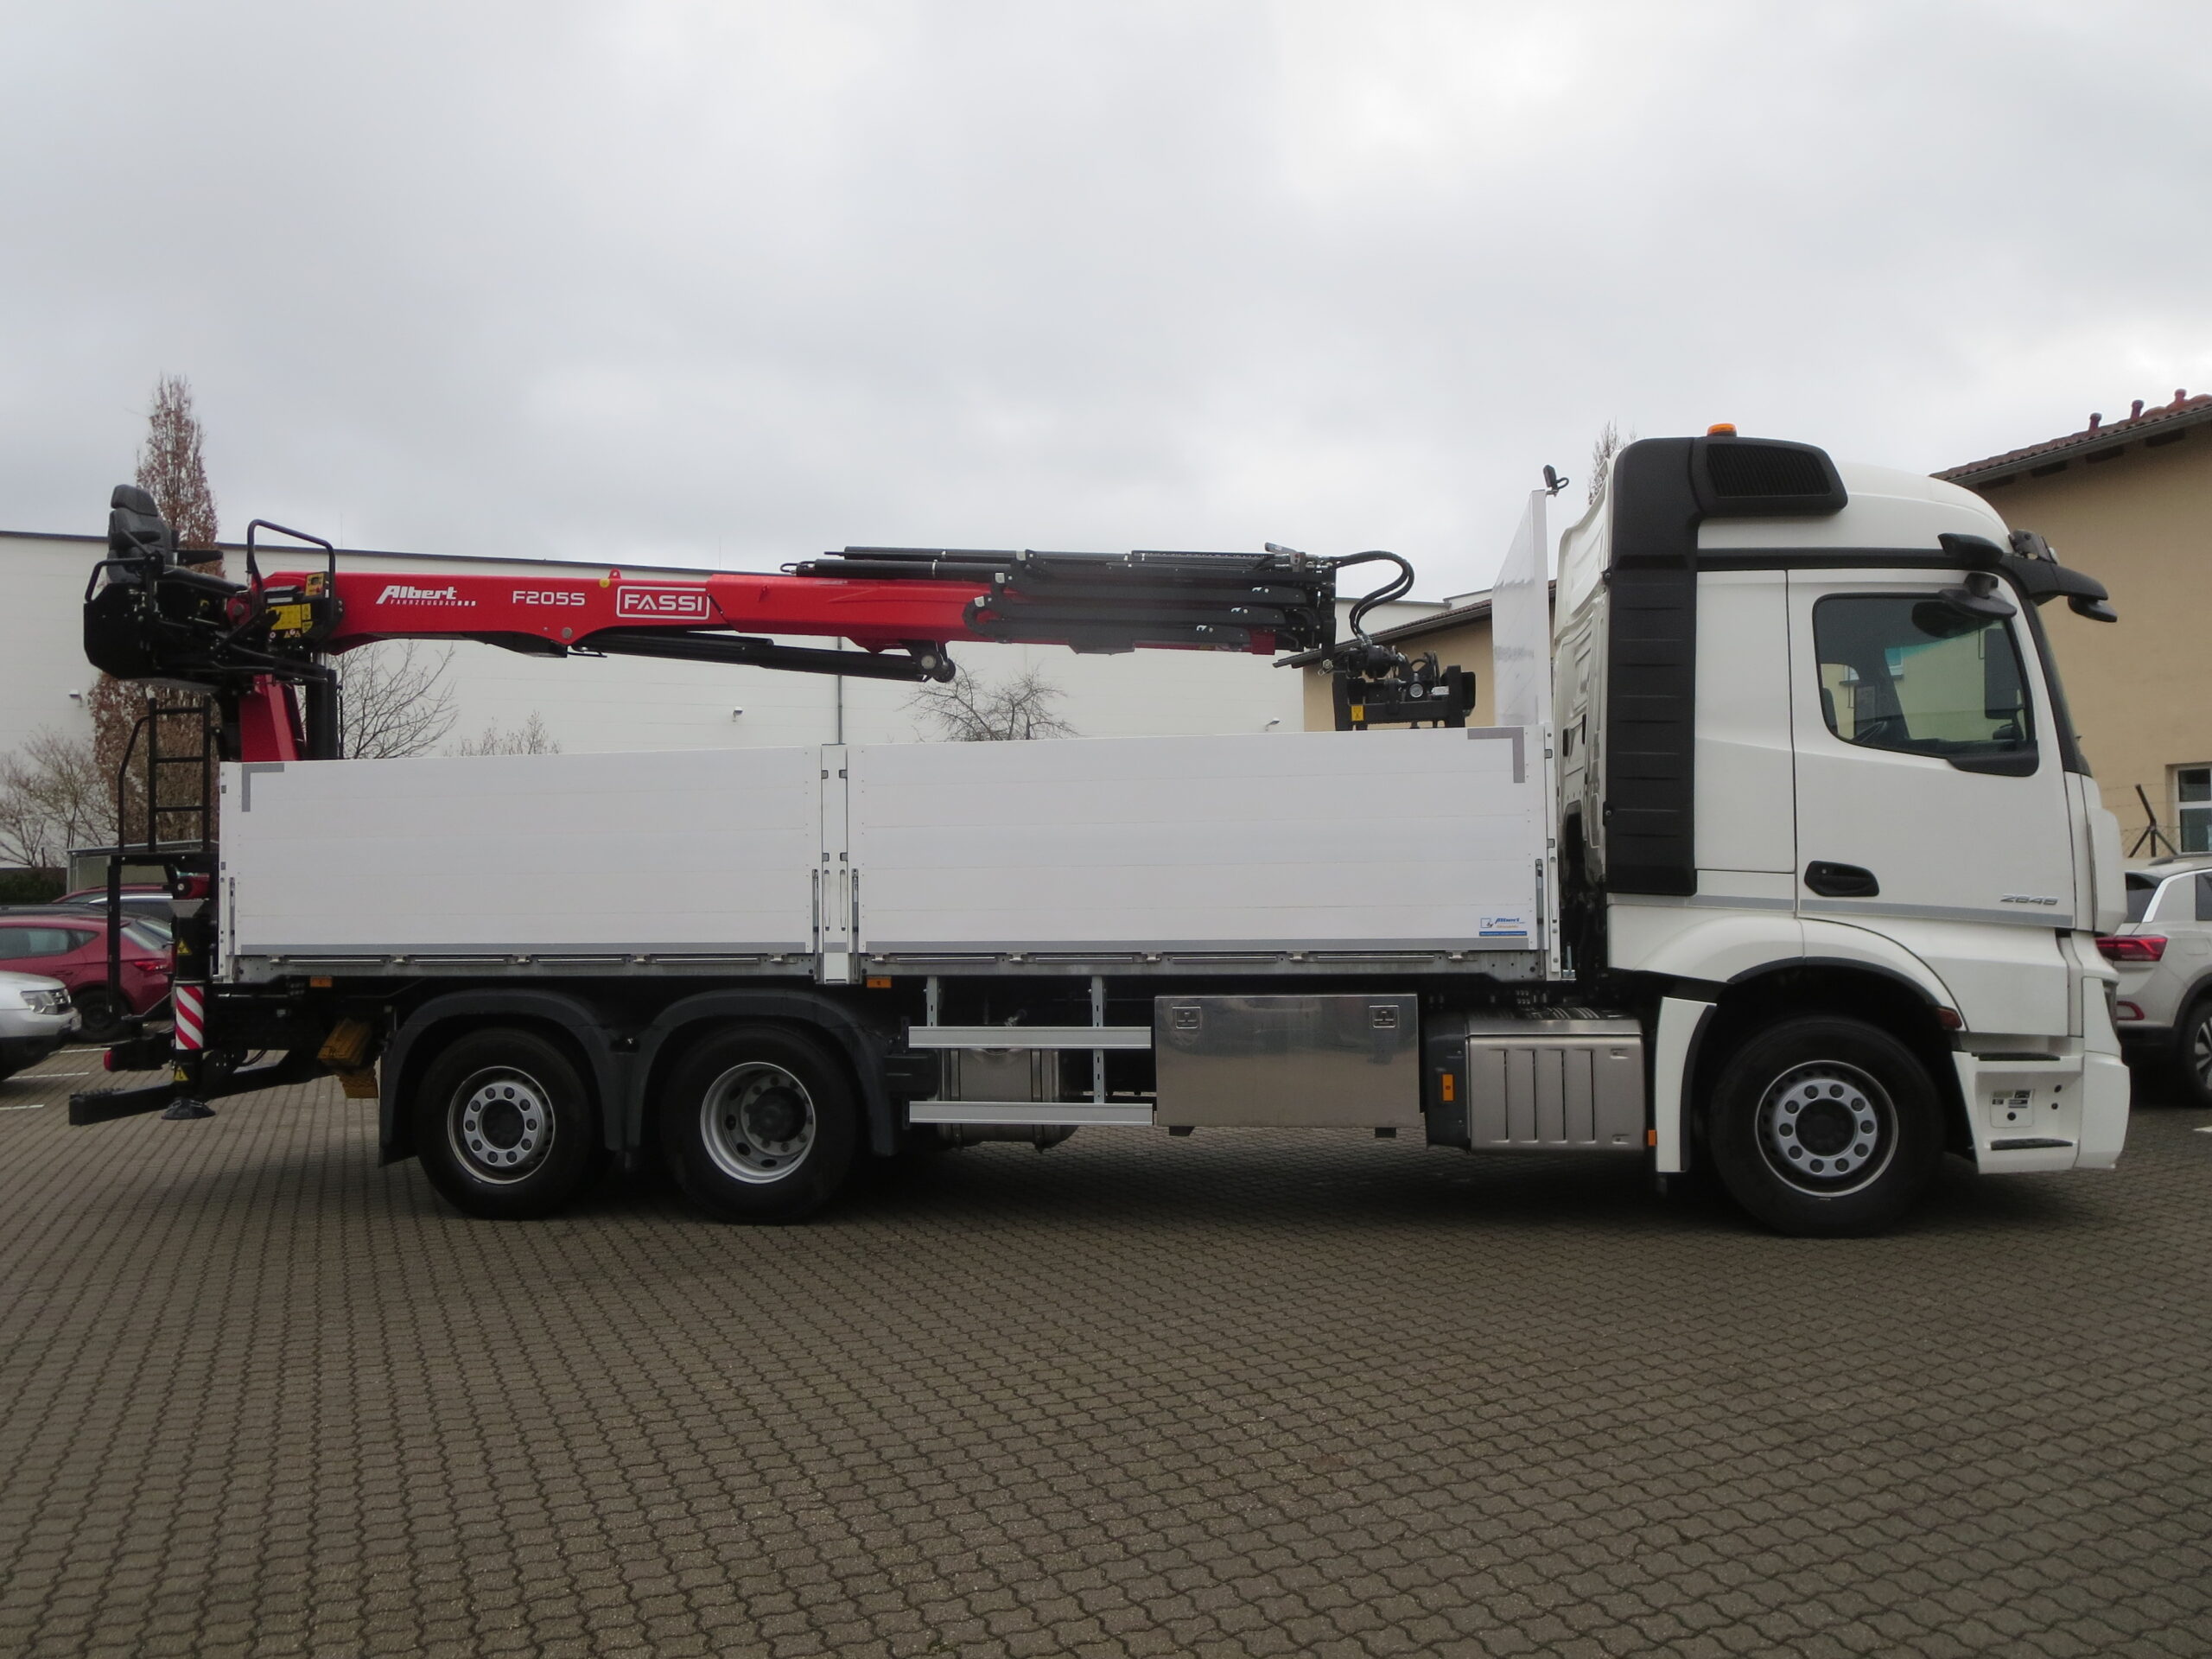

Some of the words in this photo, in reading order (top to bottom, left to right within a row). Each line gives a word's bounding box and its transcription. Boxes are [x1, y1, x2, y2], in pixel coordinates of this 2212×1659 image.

[376, 585, 458, 604] Albert
[512, 590, 586, 606] F205S
[624, 594, 702, 612] FASSI
